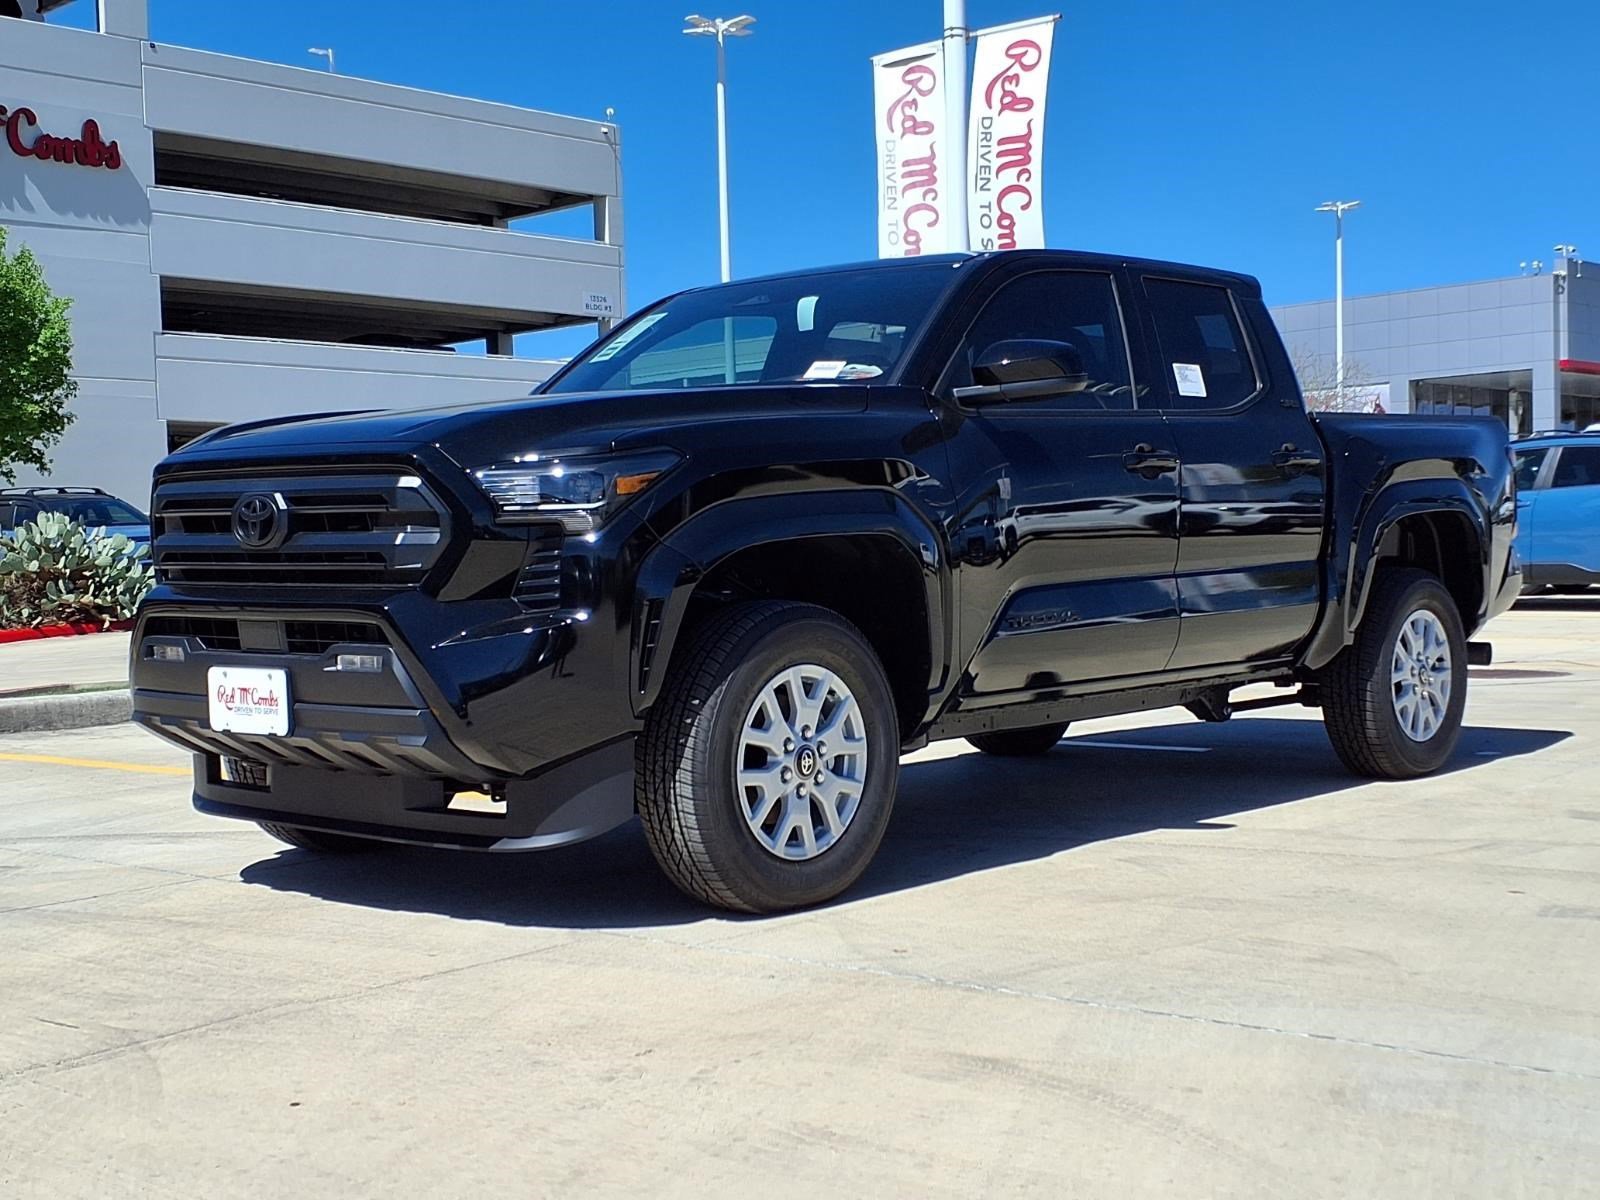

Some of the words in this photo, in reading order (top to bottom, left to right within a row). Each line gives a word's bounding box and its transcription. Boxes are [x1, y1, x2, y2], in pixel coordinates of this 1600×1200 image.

[985, 39, 1042, 117] Red
[886, 65, 937, 140] Red
[979, 116, 993, 192] DRIVEN
[885, 139, 898, 210] DRIVEN
[996, 118, 1033, 250] McCom
[979, 201, 993, 229] TO
[887, 219, 899, 246] TO
[981, 238, 994, 250] S
[585, 303, 603, 311] BLDG
[217, 684, 236, 710] Red
[237, 687, 280, 707] McCombs
[254, 707, 263, 715] TO
[263, 708, 279, 716] SERVE
